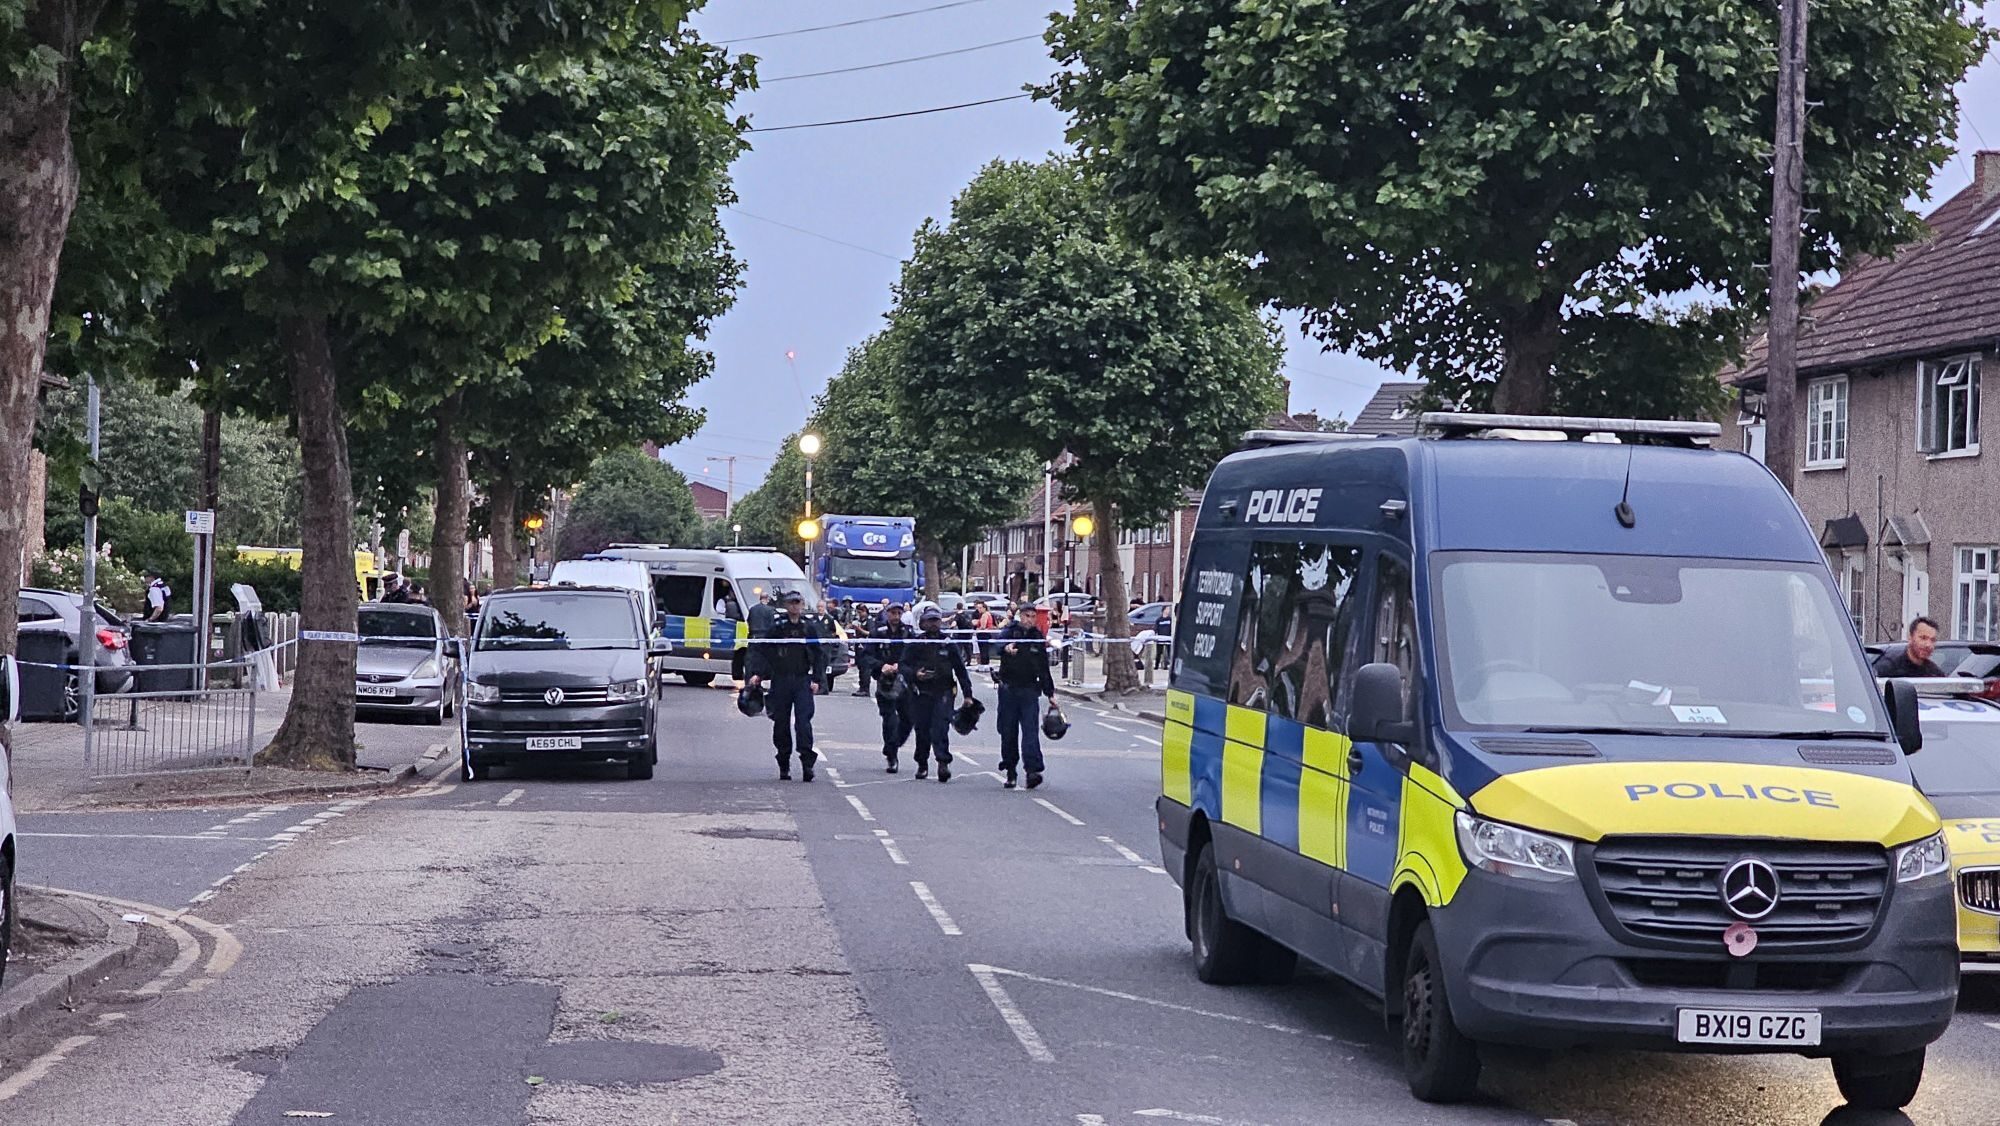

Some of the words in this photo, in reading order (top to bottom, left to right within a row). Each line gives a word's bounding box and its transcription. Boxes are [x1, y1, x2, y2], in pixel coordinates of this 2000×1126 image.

[1244, 488, 1324, 523] POLICE
[1197, 570, 1234, 597] TERRITORIAL
[1195, 601, 1225, 627] SUPPORT
[1193, 632, 1216, 658] GROUP
[531, 738, 556, 748] AE69
[557, 738, 577, 748] CHL
[1624, 783, 1840, 809] POLICE
[1696, 1014, 1751, 1038] BX19
[1759, 1016, 1806, 1039] GZG
